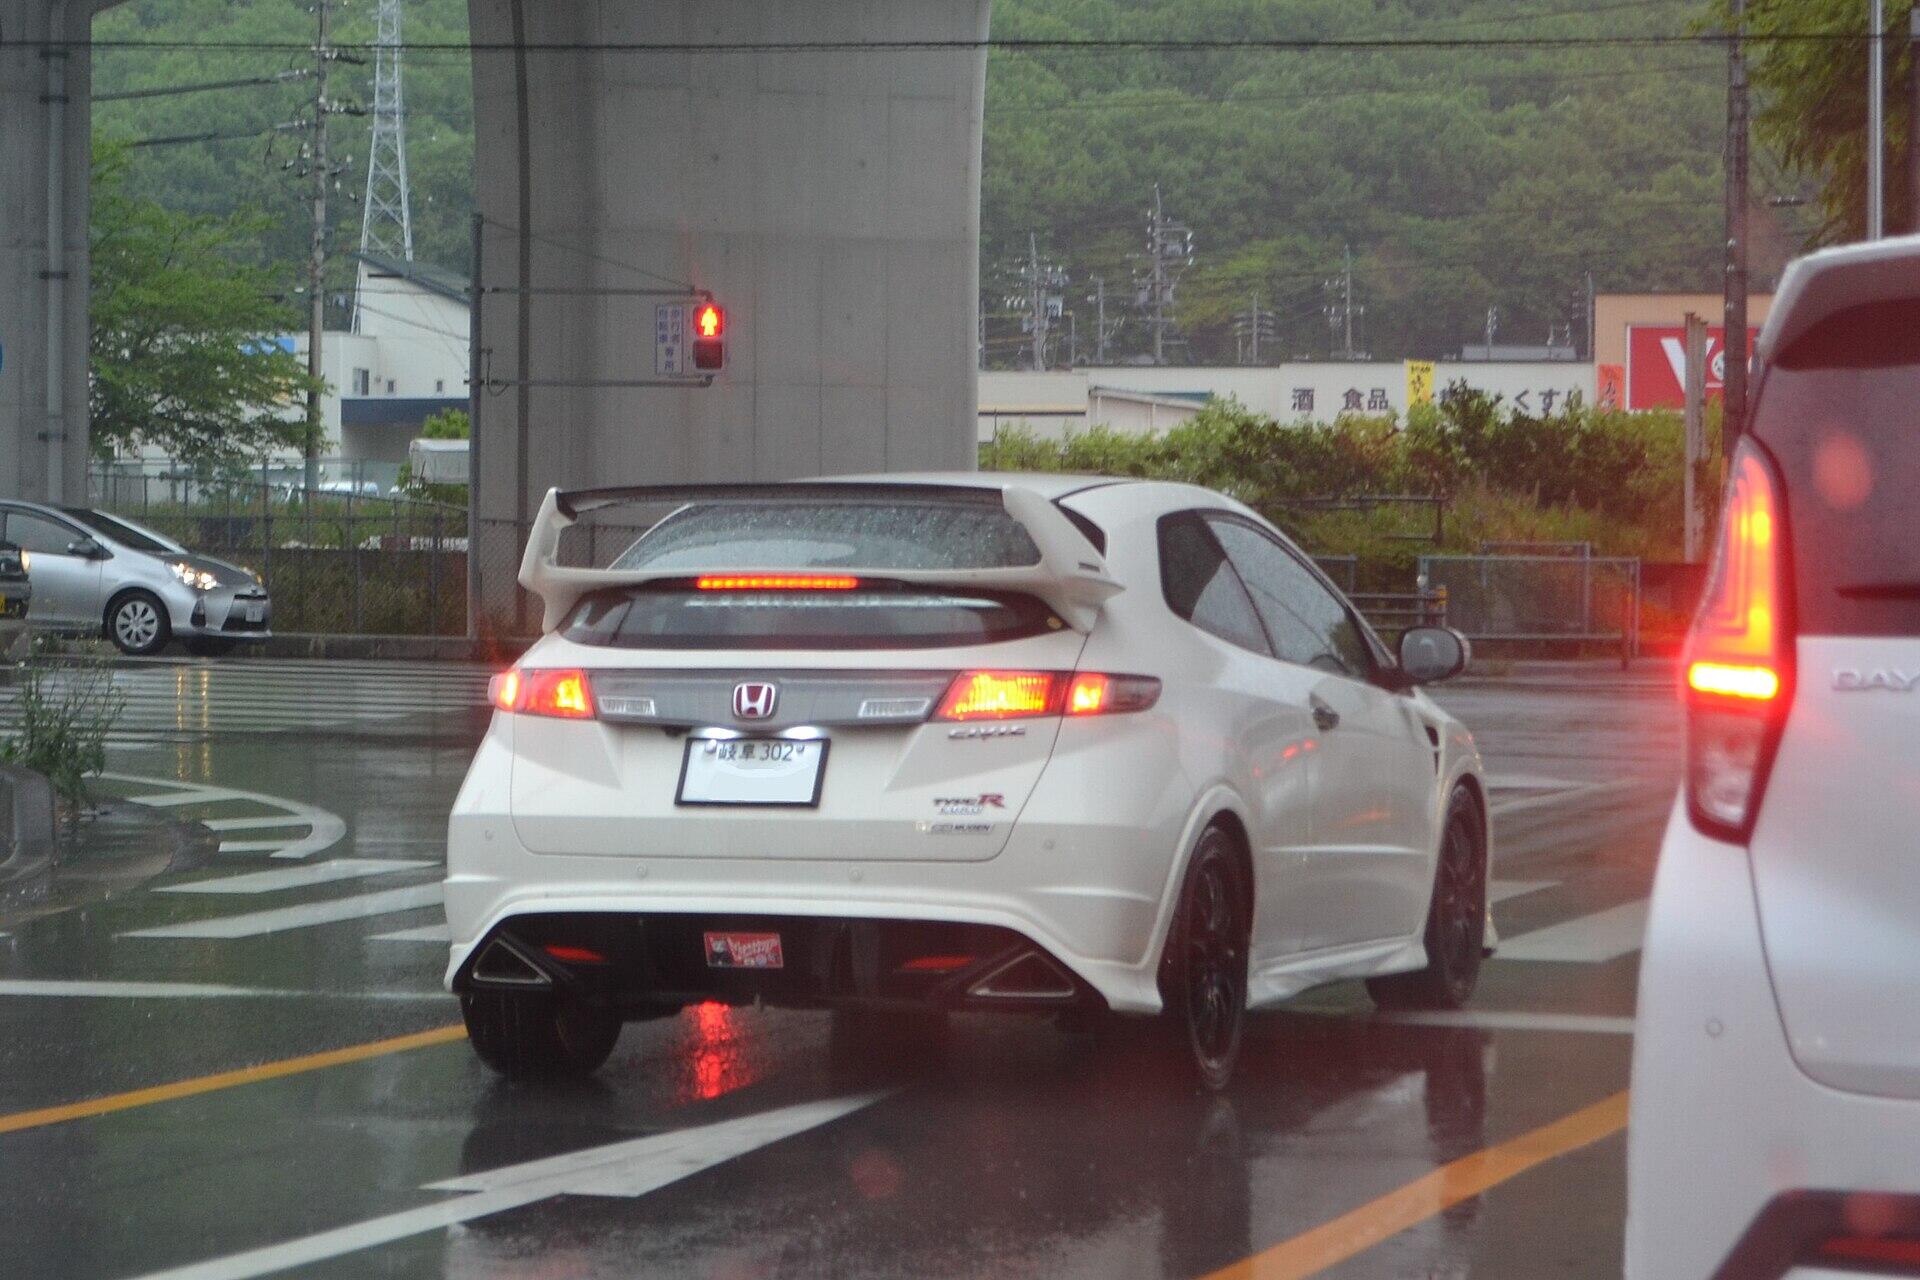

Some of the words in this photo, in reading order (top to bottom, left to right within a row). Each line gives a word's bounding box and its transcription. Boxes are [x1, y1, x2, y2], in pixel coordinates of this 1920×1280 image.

[1292, 388, 1314, 411] 酒
[1343, 388, 1388, 410] 食品
[759, 743, 794, 761] 302
[978, 794, 1005, 808] R
